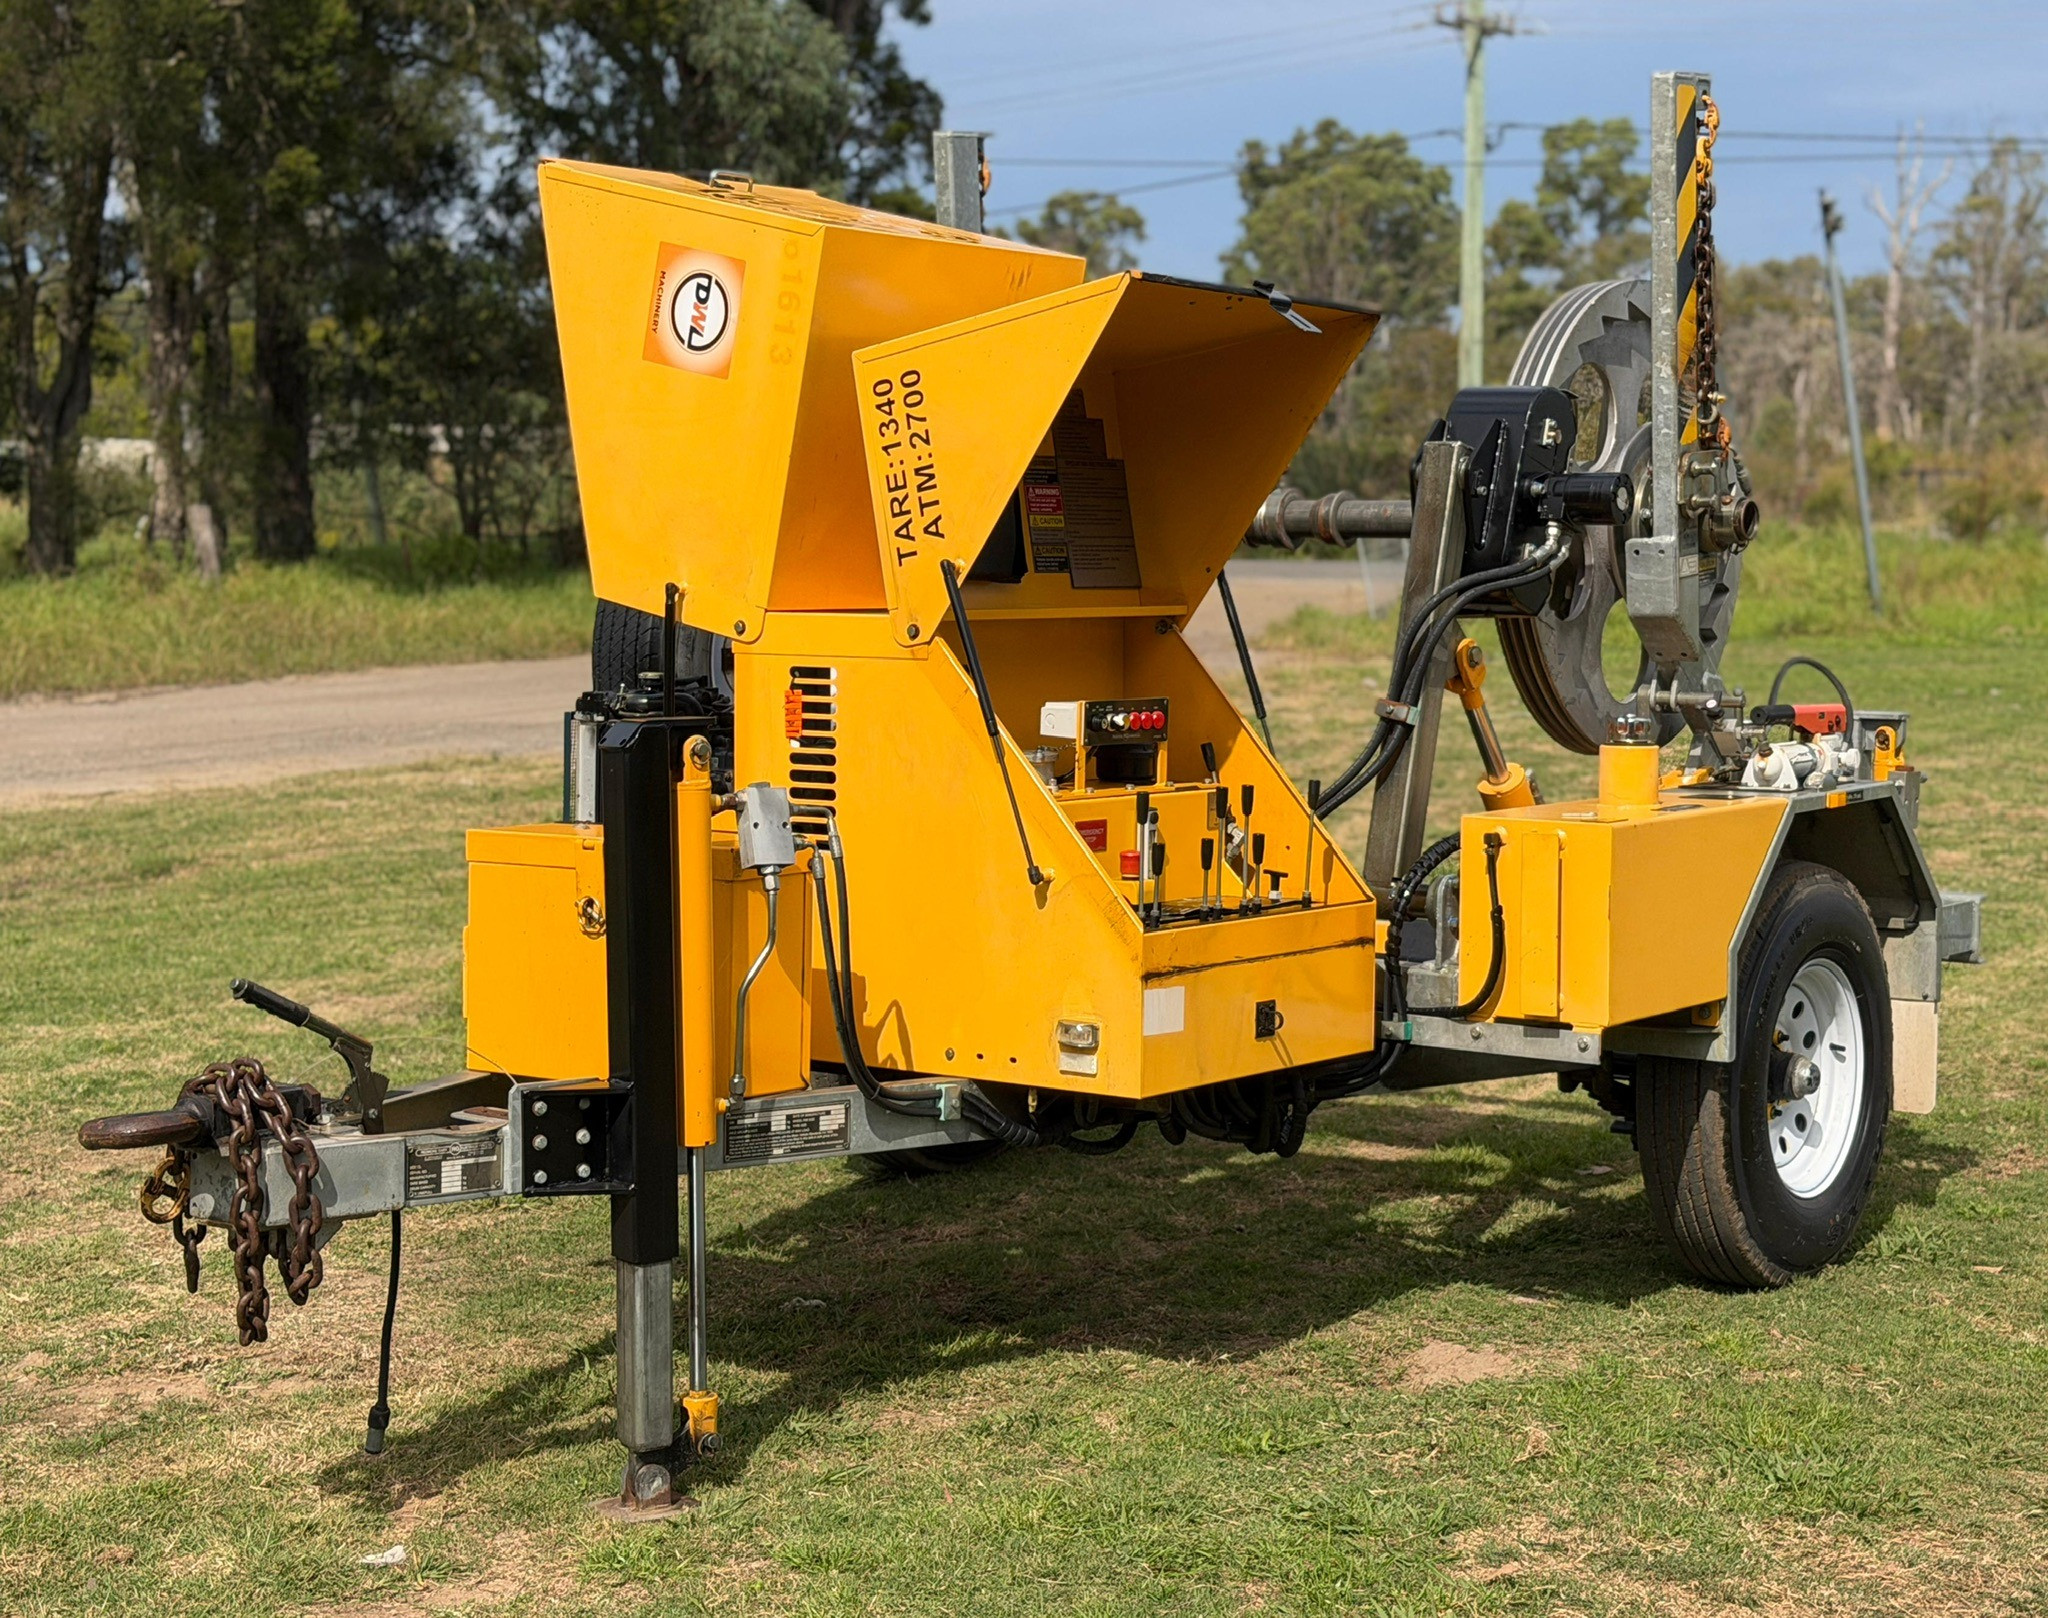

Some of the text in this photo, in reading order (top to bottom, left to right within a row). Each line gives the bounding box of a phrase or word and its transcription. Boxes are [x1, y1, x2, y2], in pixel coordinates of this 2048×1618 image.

[651, 270, 667, 334] MACHINERY
[687, 275, 713, 349] DWL
[873, 378, 918, 567] TARE:1340
[900, 369, 946, 540] ATM:2700
[1034, 487, 1060, 497] WARNING
[1039, 517, 1064, 526] CAUTION
[1041, 546, 1066, 555] CAUTION
